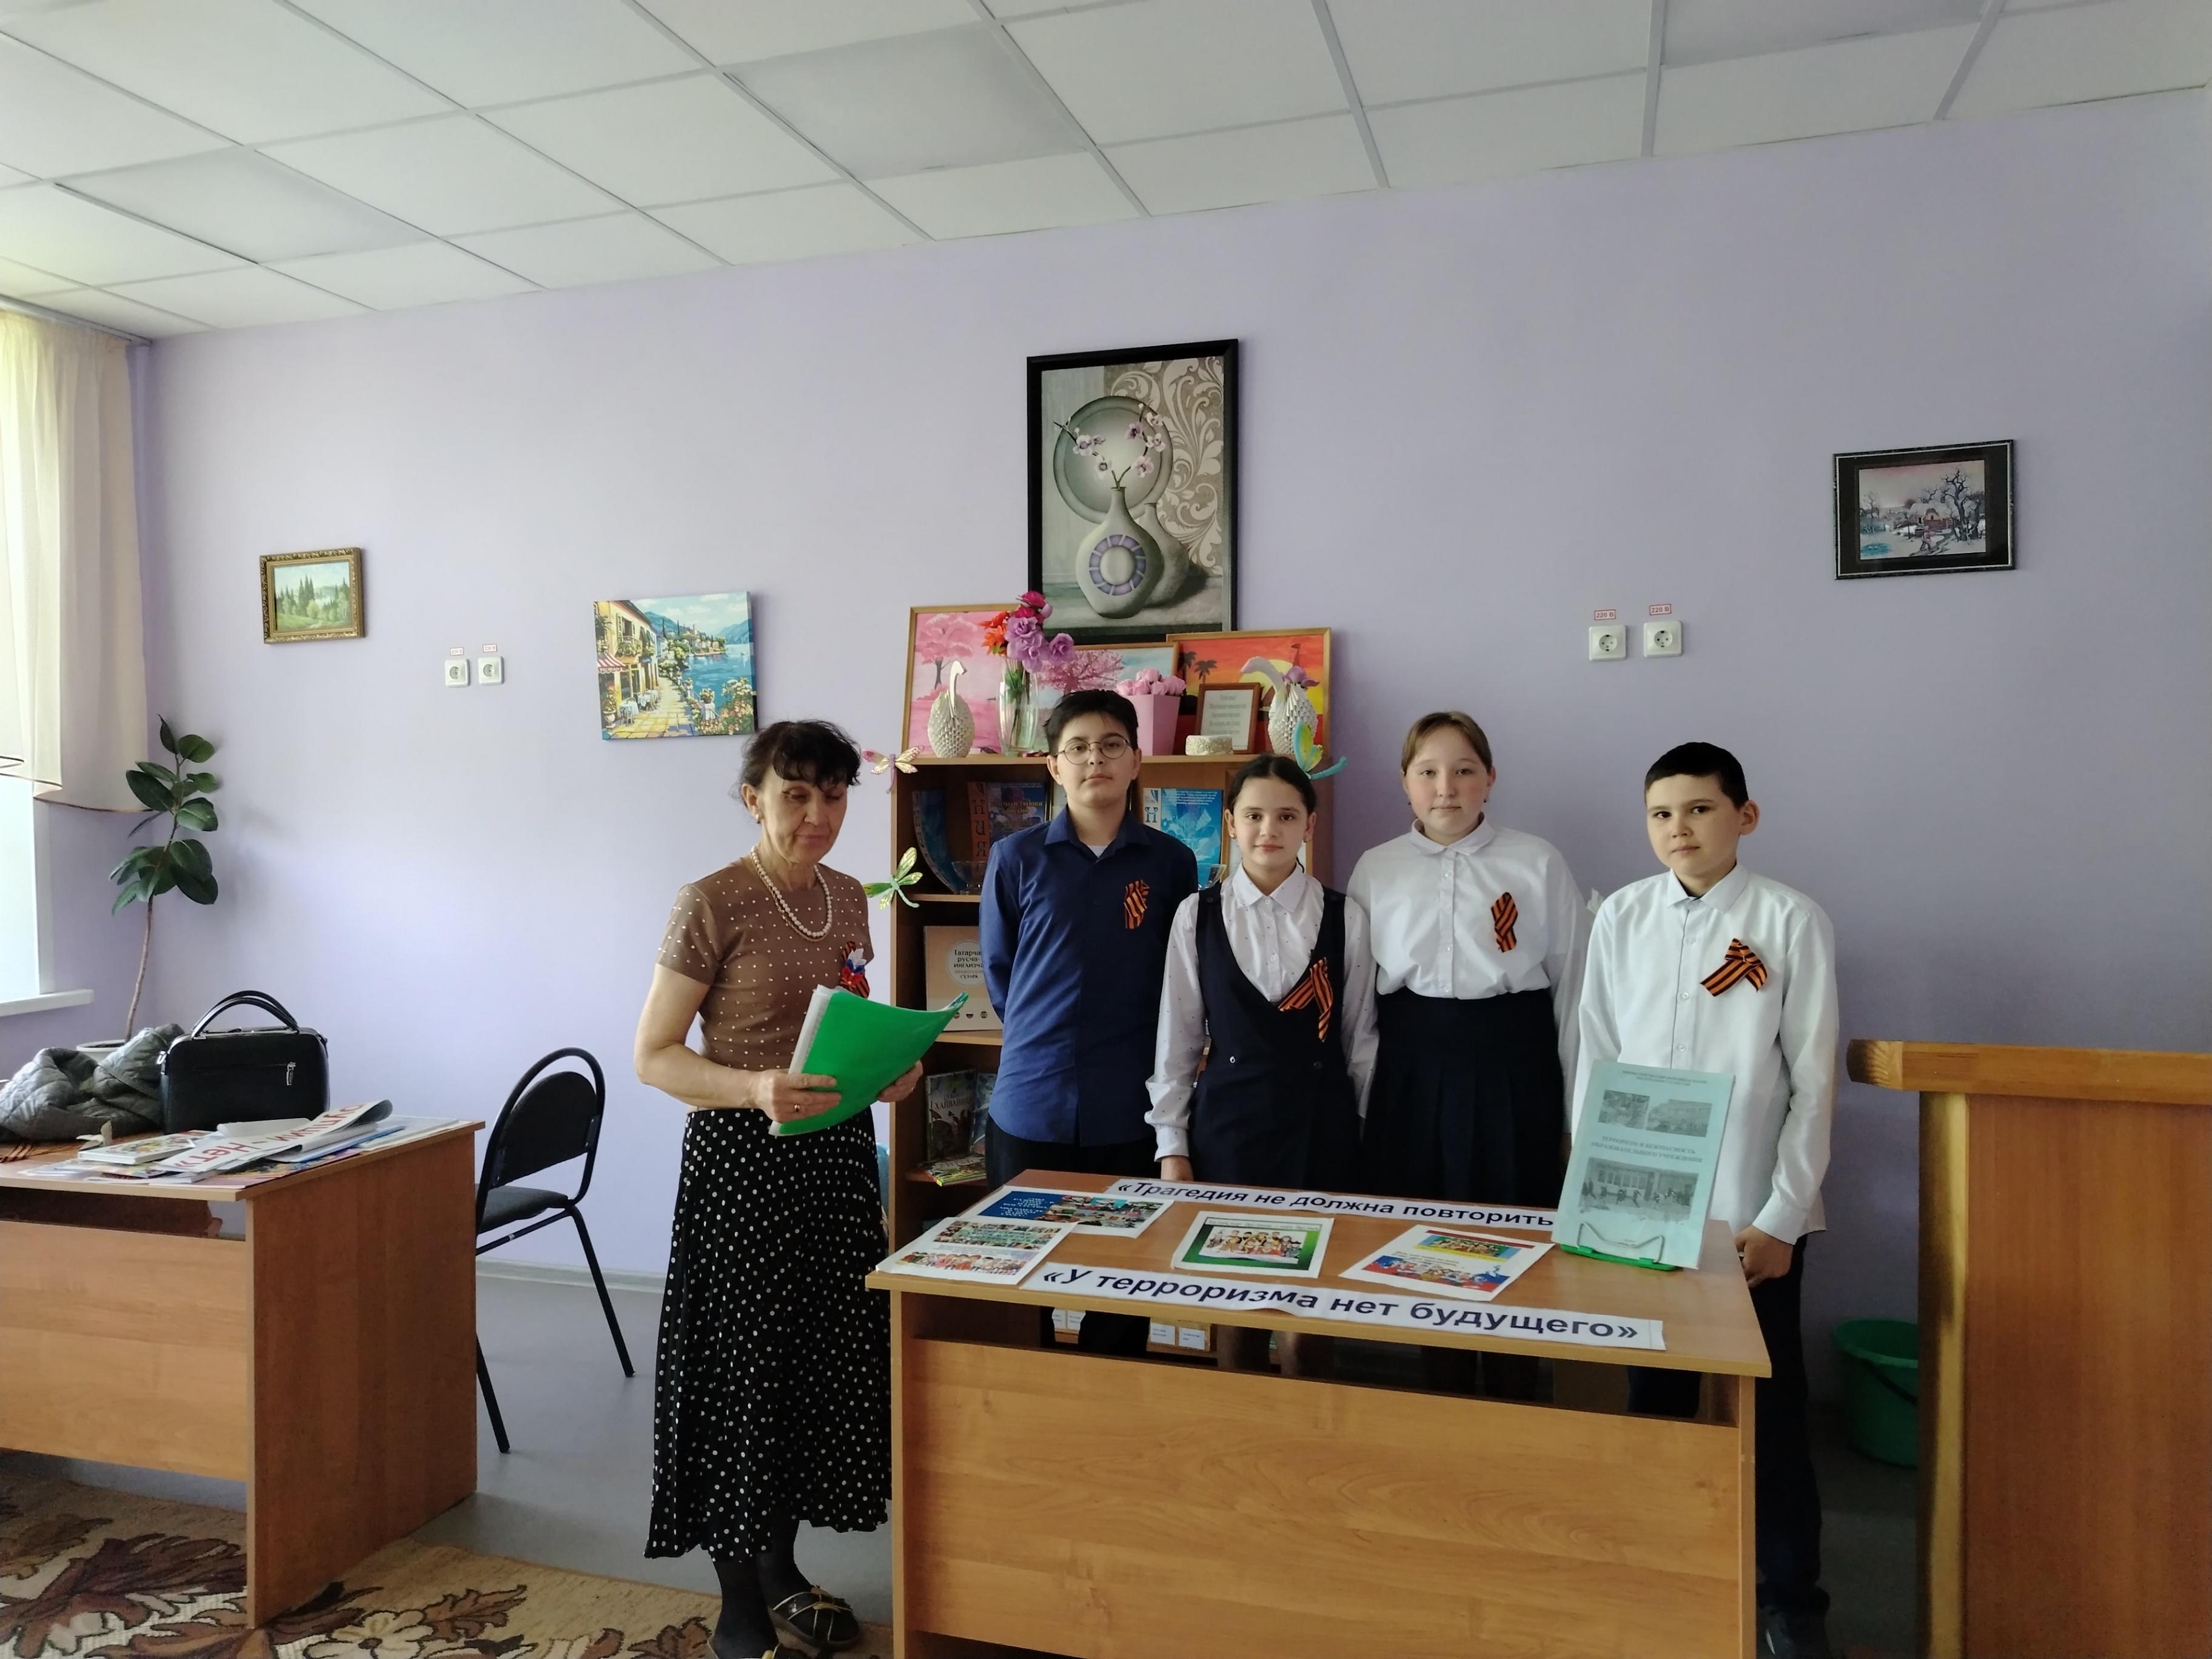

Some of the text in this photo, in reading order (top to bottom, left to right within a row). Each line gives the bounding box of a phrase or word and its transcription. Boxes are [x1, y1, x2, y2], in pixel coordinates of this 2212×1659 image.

[175, 1142, 261, 1168] Нет»
[1601, 1136, 1638, 1147] ТЕРРОРИЗМ
[1645, 1143, 1696, 1154] БЕЗОПАСНОСТЬ
[1118, 1182, 1553, 1225] «Трагедия не должна повторить
[1043, 1269, 1638, 1339] «У терроризма нет будущего»
